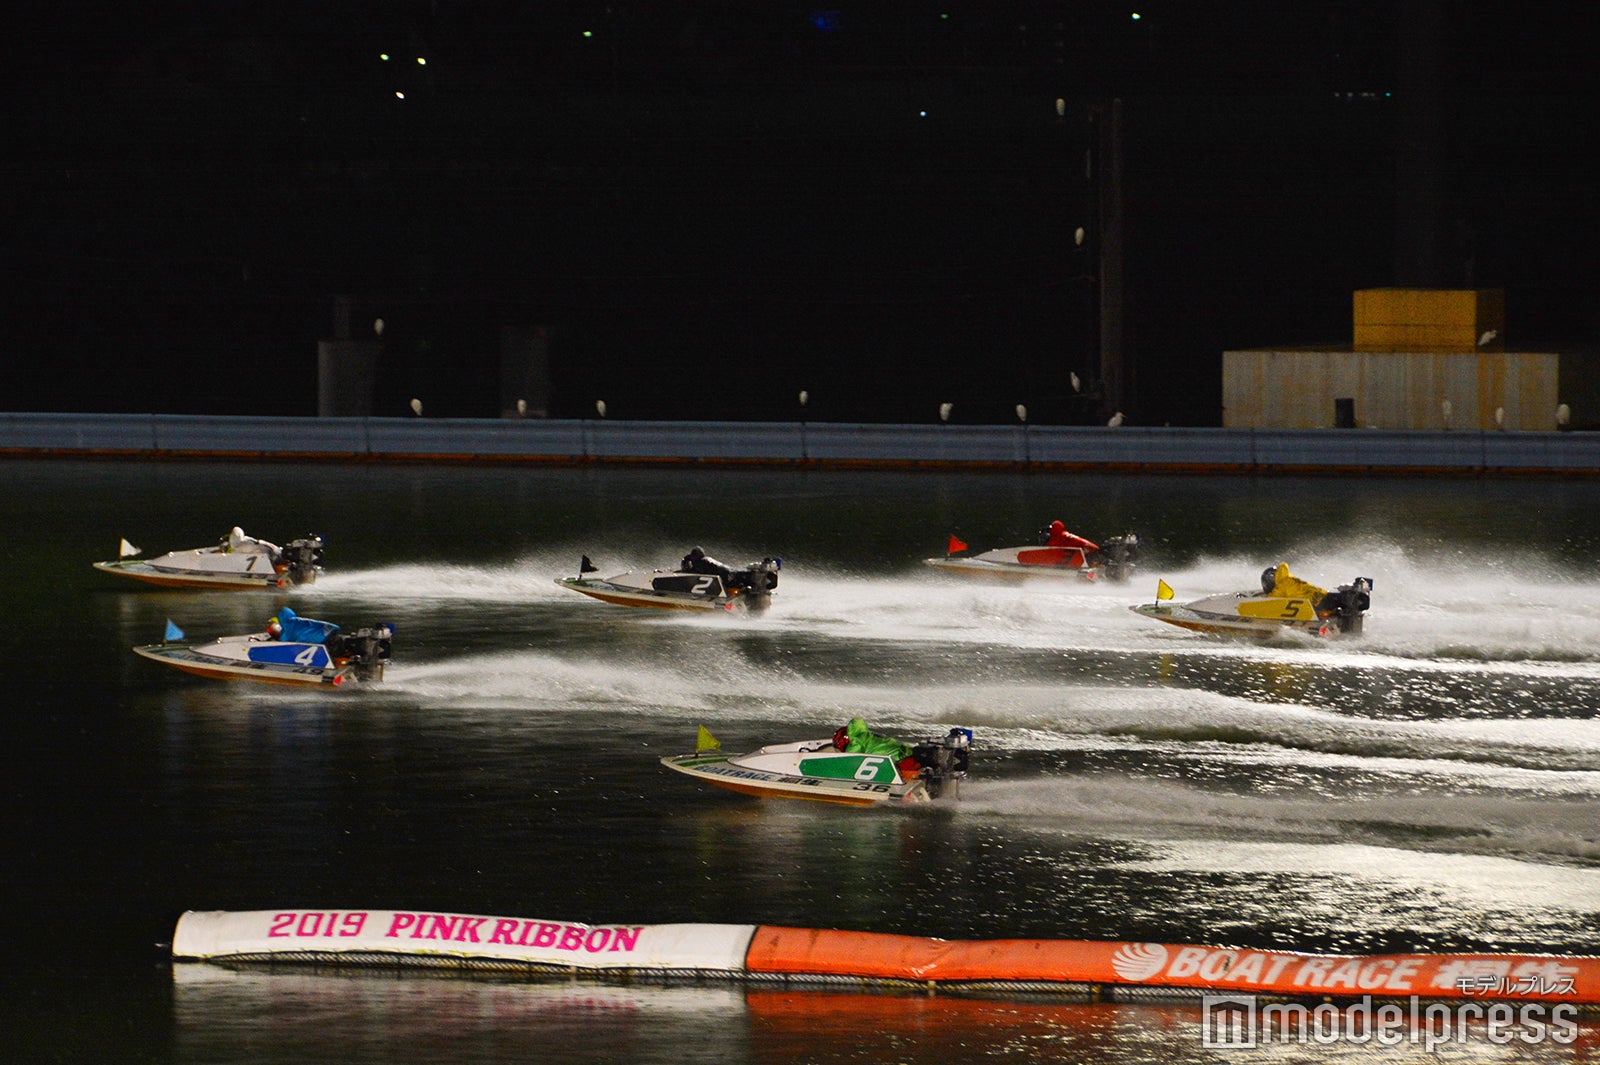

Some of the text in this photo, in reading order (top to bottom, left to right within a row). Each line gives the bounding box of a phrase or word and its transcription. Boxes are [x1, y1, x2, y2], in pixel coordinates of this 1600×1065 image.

[246, 556, 258, 572] 1
[691, 577, 713, 594] 2
[1280, 600, 1303, 617] 5
[294, 645, 318, 666] 4
[854, 757, 885, 780] 6
[852, 783, 892, 793] 36
[268, 912, 645, 953] 2019 PINK RIBBON
[1166, 946, 1299, 985] BOAT
[1292, 956, 1425, 990] RACE
